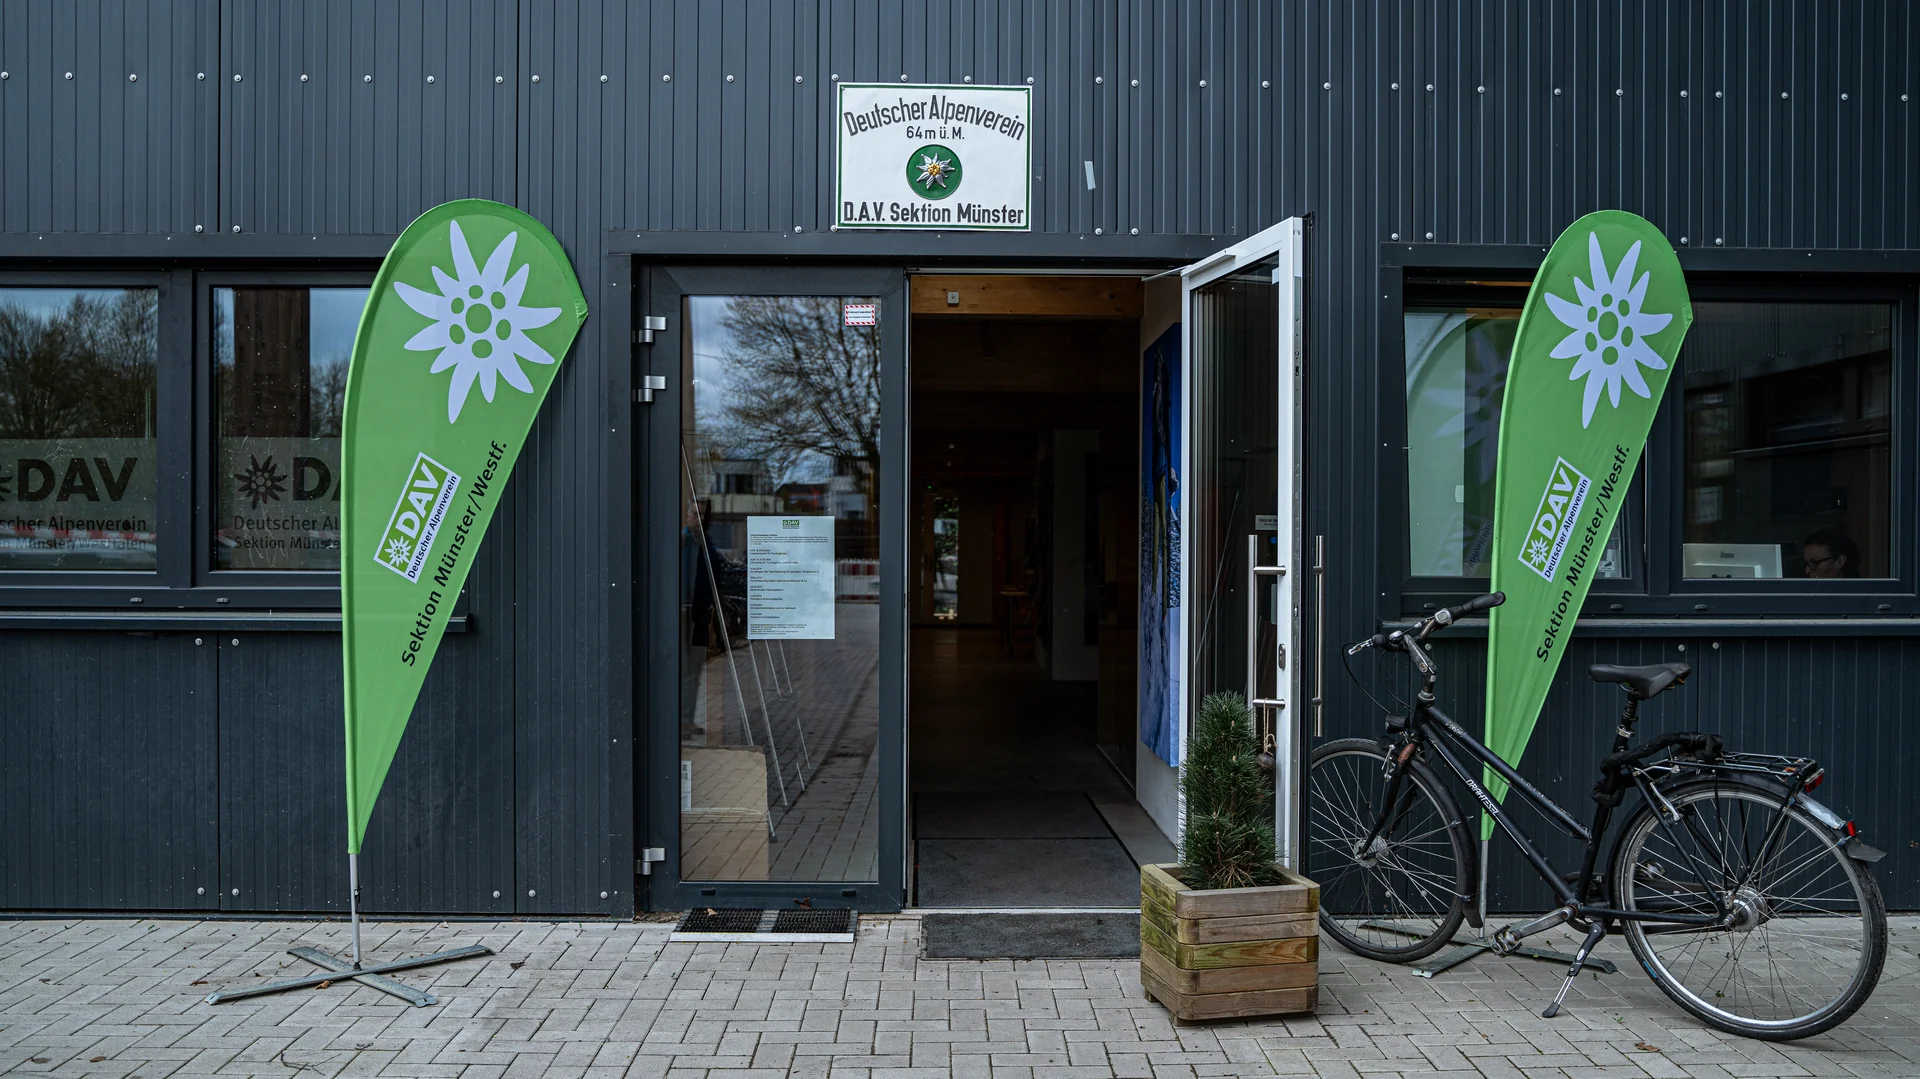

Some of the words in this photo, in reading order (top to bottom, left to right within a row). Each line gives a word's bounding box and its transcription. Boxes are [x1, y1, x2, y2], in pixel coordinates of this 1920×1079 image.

[843, 97, 928, 137] Deutscher
[928, 94, 1026, 141] Alpenverein
[843, 201, 886, 222] D.A.V.
[890, 202, 951, 223] Sektion
[957, 202, 1024, 224] Münster
[17, 457, 139, 502] DAV
[395, 462, 440, 540] DAV
[1536, 466, 1574, 541] DAV
[233, 515, 318, 531] Deutscher
[234, 535, 285, 549] Sektion
[401, 590, 443, 667] Sektion
[433, 440, 508, 588] Münster/Westf.
[407, 529, 433, 580] Deutscher
[429, 474, 457, 531] Alpenverein
[1536, 591, 1573, 663] Sektion
[1565, 444, 1631, 588] Münster/Westf.
[1544, 531, 1567, 579] Deutscher
[1563, 478, 1589, 533] Alpenverein
[1465, 779, 1499, 815] DRAHTESEL
